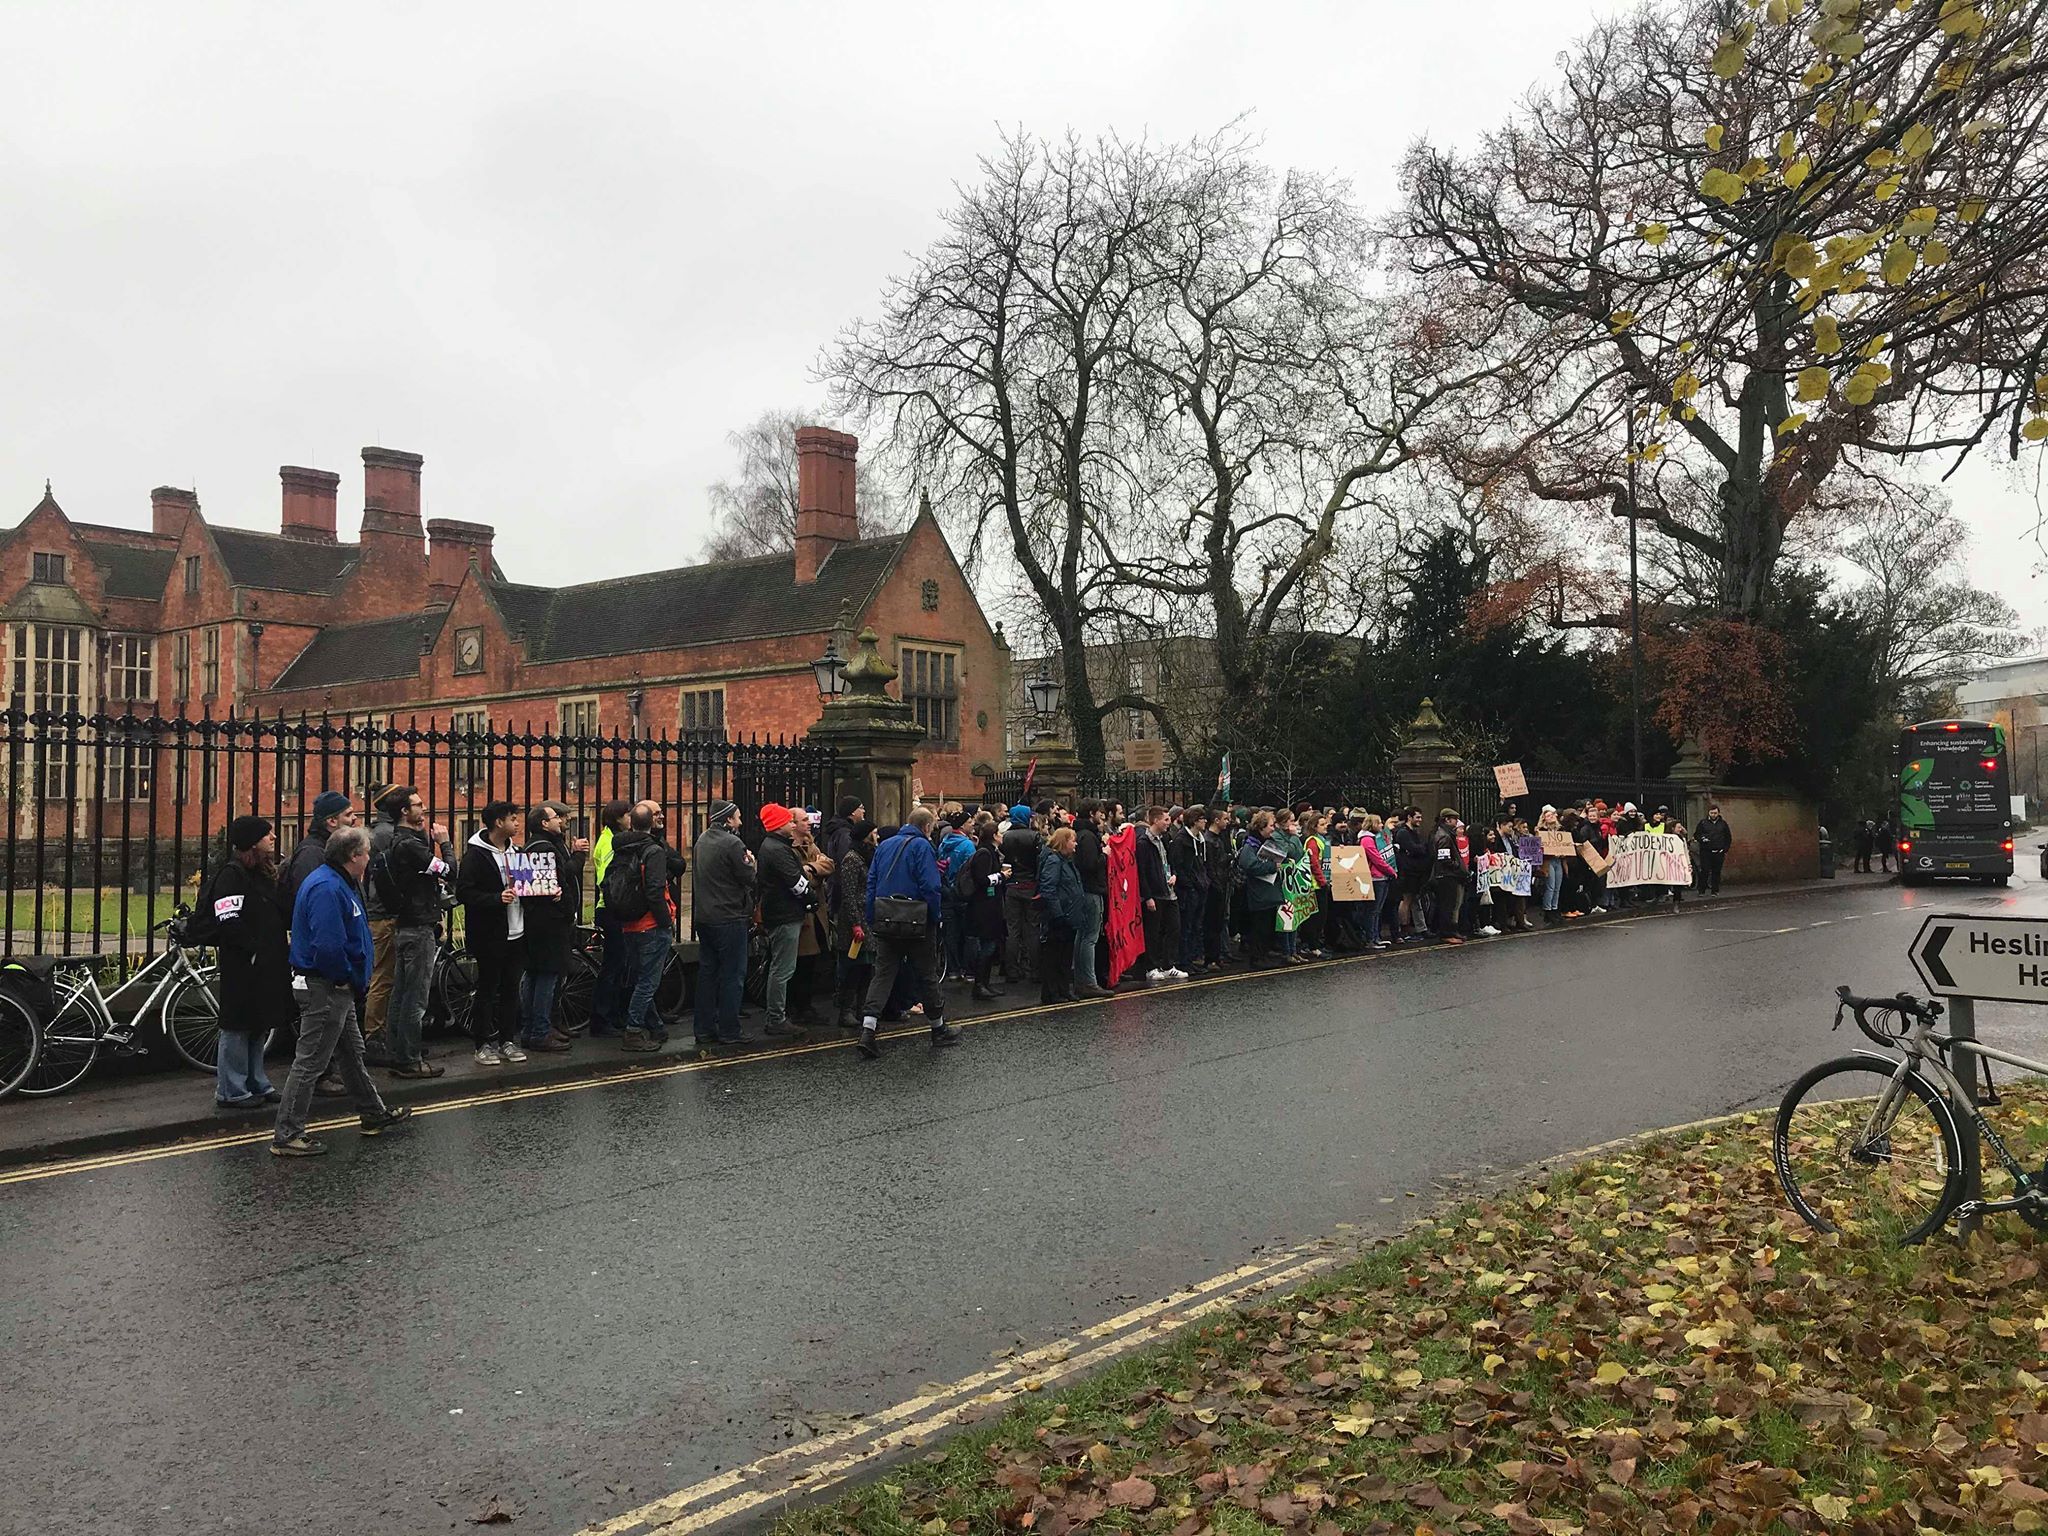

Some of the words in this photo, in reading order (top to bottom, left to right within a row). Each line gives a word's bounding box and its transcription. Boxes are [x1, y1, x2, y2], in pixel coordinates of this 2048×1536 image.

[1630, 834, 1674, 853] STUDENTS
[506, 852, 557, 870] WAGES
[1635, 850, 1656, 881] UCU
[216, 898, 240, 911] UCU
[1976, 1120, 2012, 1166] GENESIS
